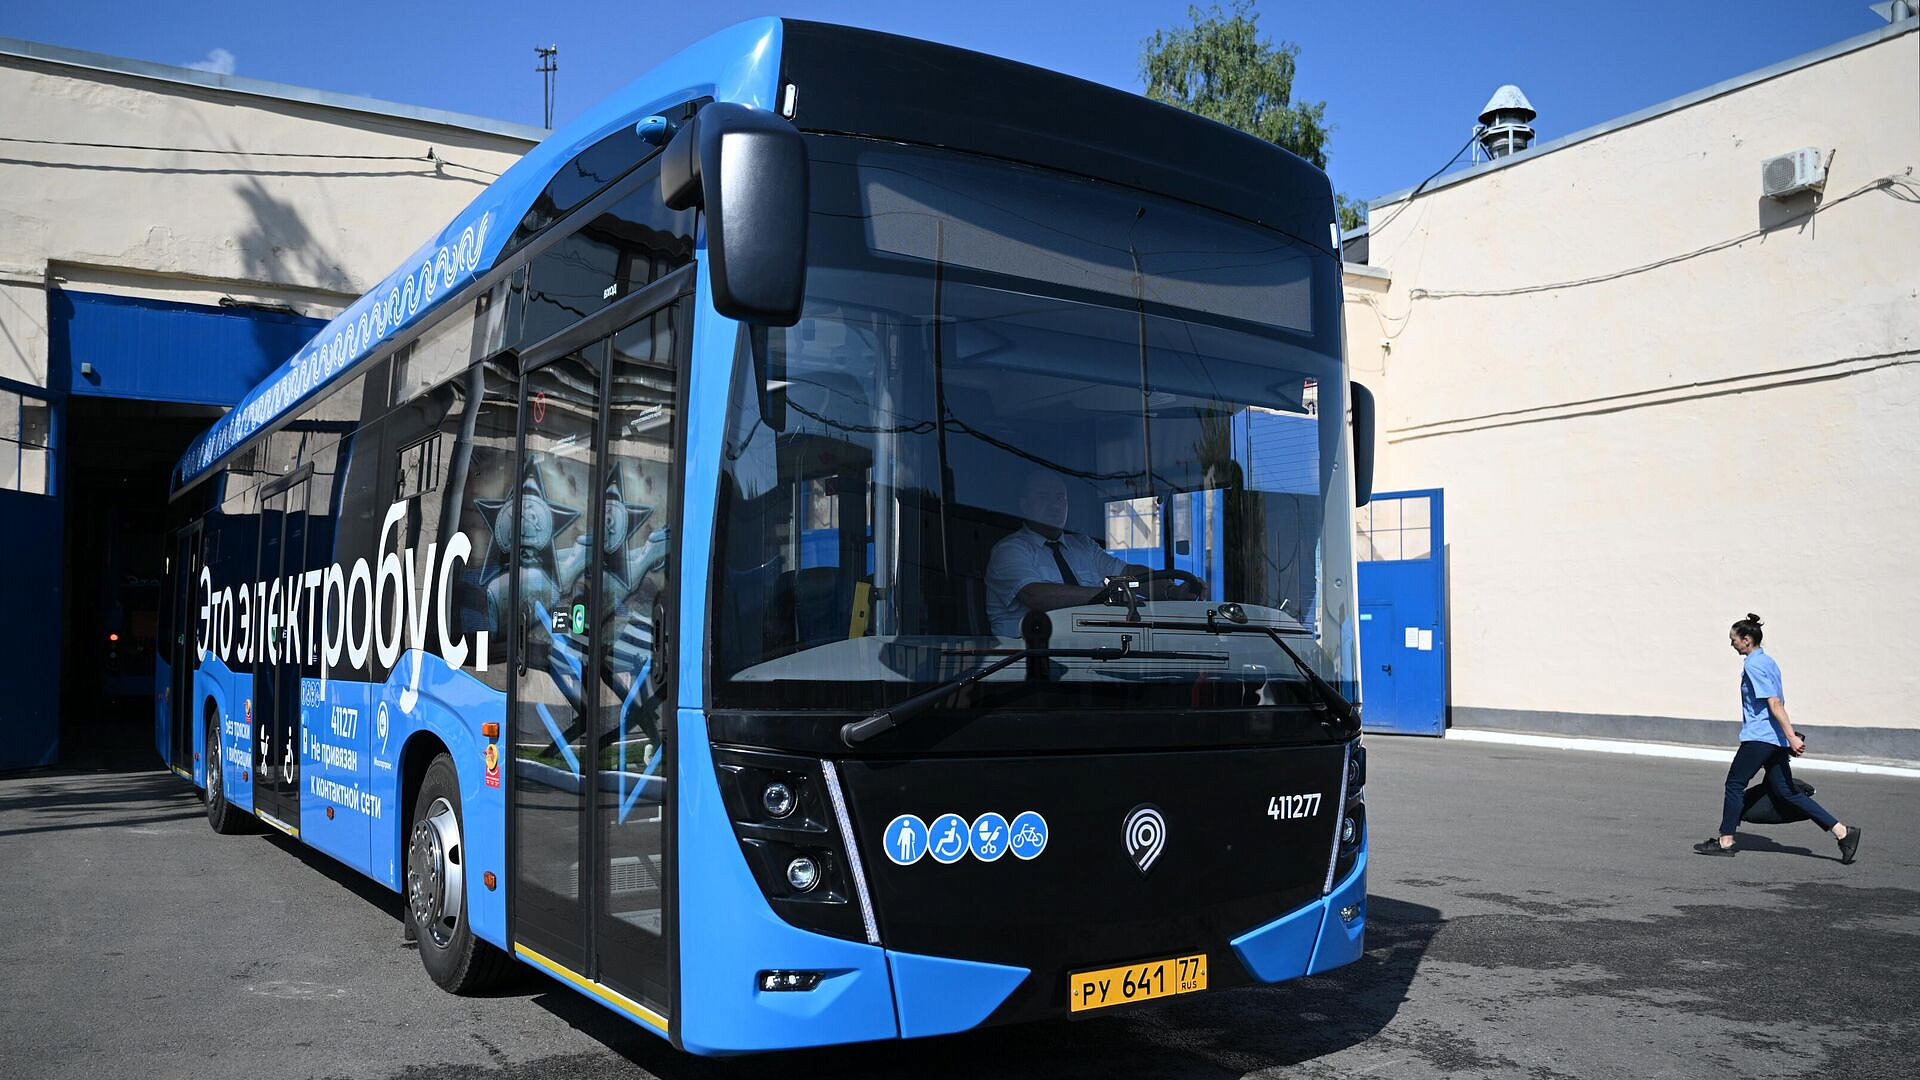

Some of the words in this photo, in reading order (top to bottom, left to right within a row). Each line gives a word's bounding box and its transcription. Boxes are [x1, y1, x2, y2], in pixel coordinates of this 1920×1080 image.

[197, 565, 234, 664] Это
[238, 500, 489, 715] электробус.
[331, 705, 359, 740] 411277
[310, 733, 321, 762] Не
[321, 743, 358, 772] привязан
[310, 775, 316, 795] к
[316, 775, 360, 812] контактной
[360, 792, 382, 820] сети
[1267, 793, 1322, 820] 411277
[1122, 965, 1164, 999] 641
[1179, 958, 1200, 981] 77
[1181, 980, 1197, 991] RUS
